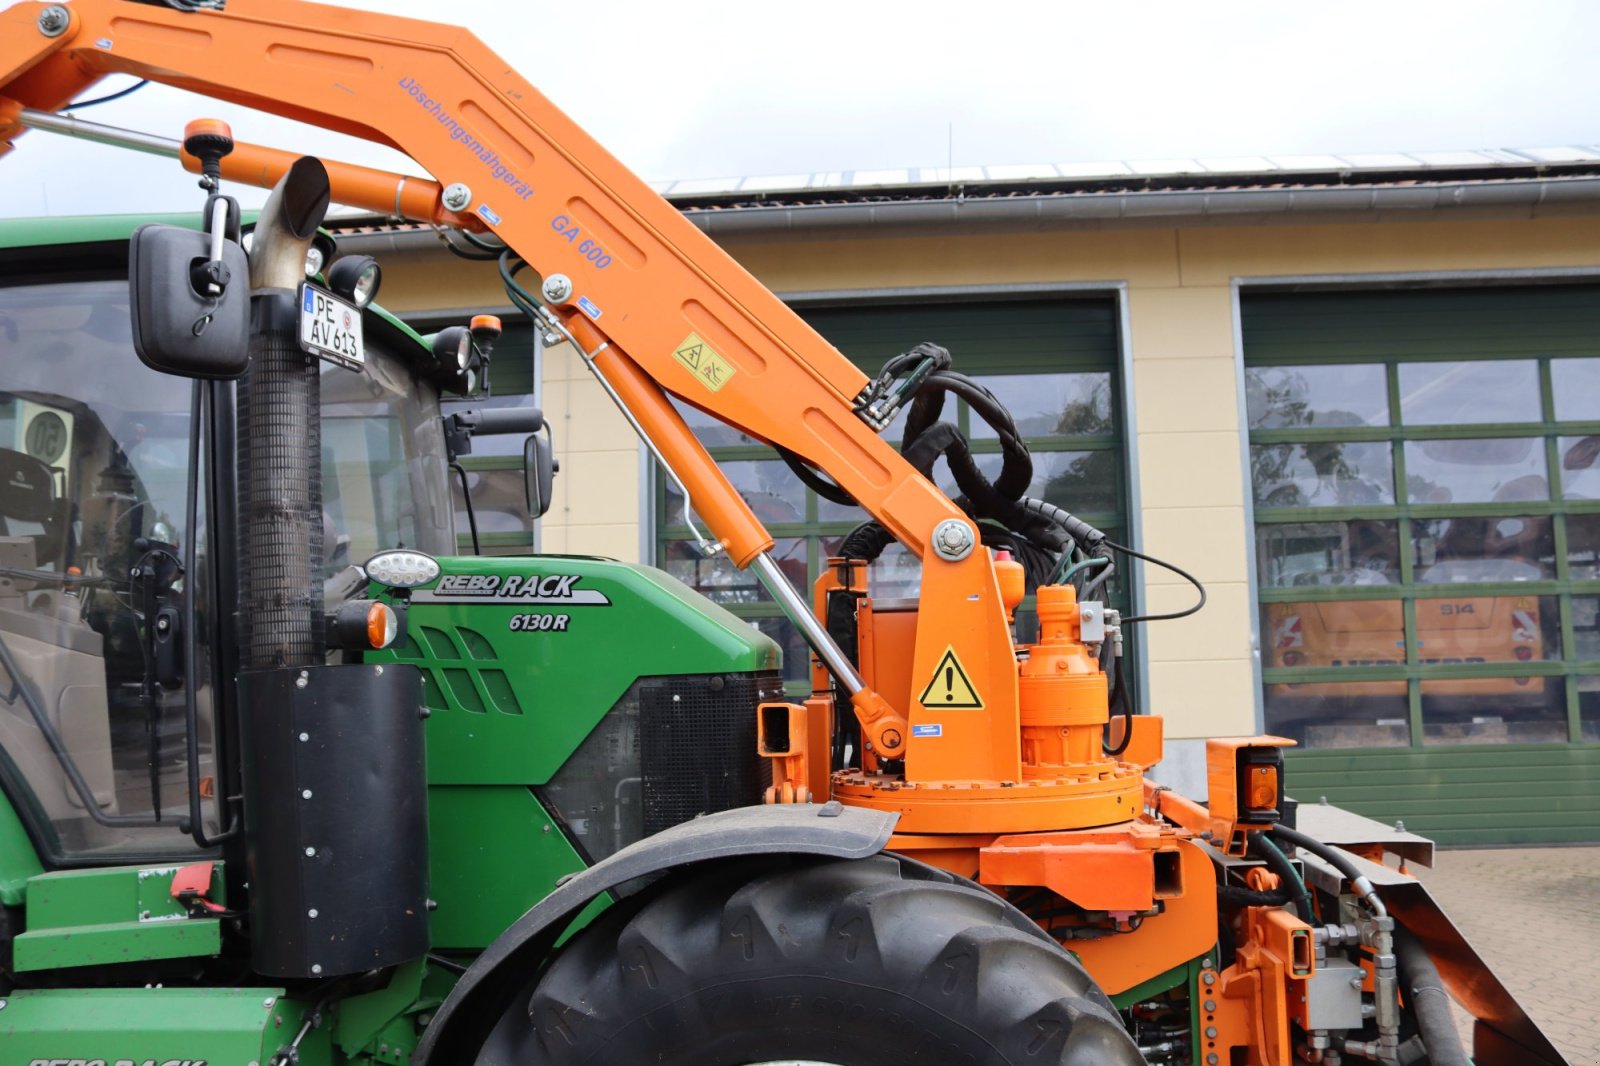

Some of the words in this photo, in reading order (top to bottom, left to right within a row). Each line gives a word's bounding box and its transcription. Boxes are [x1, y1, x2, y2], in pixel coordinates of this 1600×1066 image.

[551, 215, 580, 243] GA
[578, 239, 612, 269] 600
[316, 295, 335, 324] PE
[311, 320, 330, 346] AV
[333, 328, 357, 357] 613
[434, 575, 500, 592] REBO
[498, 575, 581, 597] RACK
